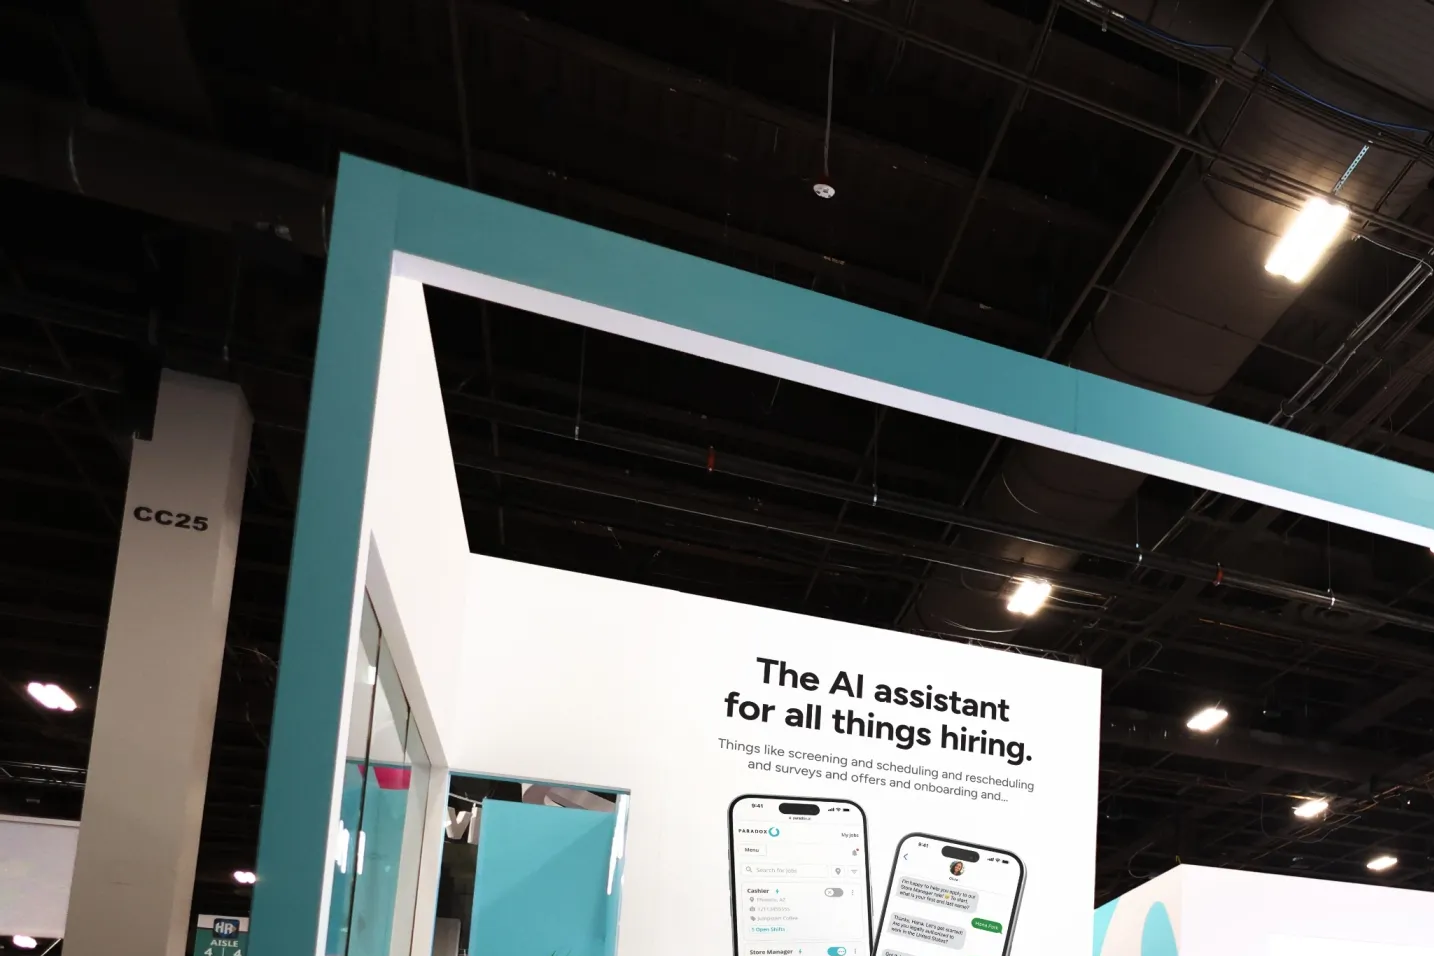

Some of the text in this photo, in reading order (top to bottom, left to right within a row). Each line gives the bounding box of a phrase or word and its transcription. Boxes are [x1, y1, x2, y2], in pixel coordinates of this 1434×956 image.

[133, 506, 208, 532] CC25
[756, 656, 1010, 723] The AI assistant
[724, 691, 1033, 766] for all things hiring.
[718, 737, 1035, 793] Things like screening and scheduling and rescheduling
[748, 760, 772, 771] and
[775, 763, 822, 779] surveys
[825, 771, 848, 781] and
[851, 773, 886, 787] offers
[889, 779, 911, 789] and
[914, 782, 978, 800] onboarding
[210, 939, 239, 948] AISLE
